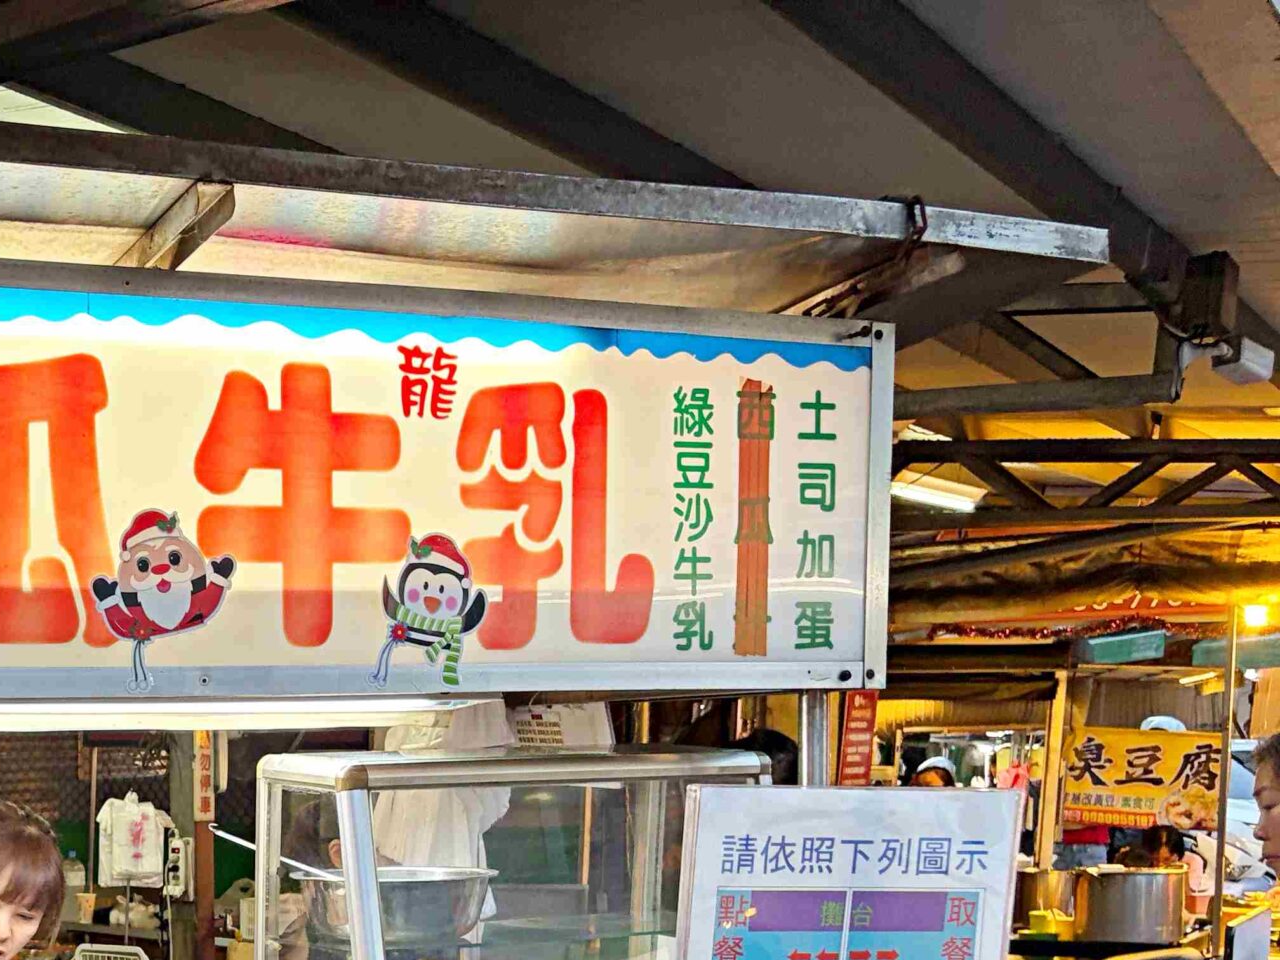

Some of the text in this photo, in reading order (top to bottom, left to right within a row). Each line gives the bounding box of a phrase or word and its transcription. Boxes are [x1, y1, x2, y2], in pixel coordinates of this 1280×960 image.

[673, 386, 714, 652] 綠豆沙牛乳
[795, 390, 837, 649] 土司加蛋
[1067, 736, 1222, 791] 臭豆腐
[721, 835, 989, 876] 請依照下列圖示
[820, 900, 874, 927] 攤台
